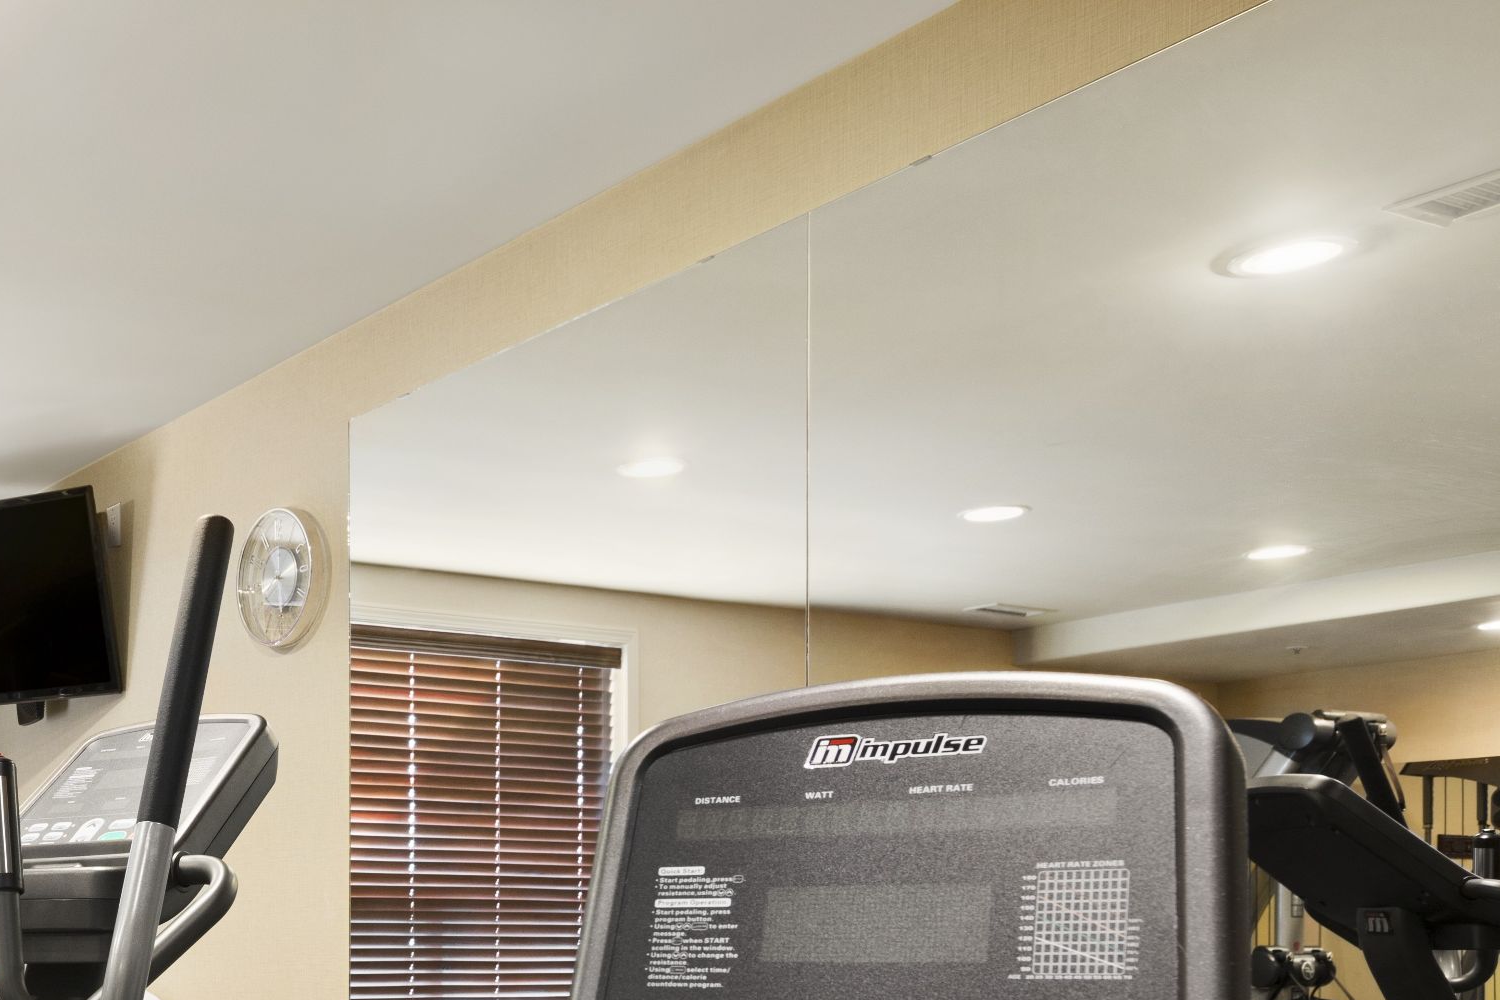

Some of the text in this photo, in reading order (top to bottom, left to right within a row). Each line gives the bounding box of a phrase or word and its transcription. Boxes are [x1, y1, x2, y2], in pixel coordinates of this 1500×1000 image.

[857, 735, 985, 761] impulse
[1048, 776, 1104, 786] CALORIES
[909, 784, 974, 794] HEART RATE
[695, 796, 740, 804] DISTANCE
[805, 791, 834, 799] WATT
